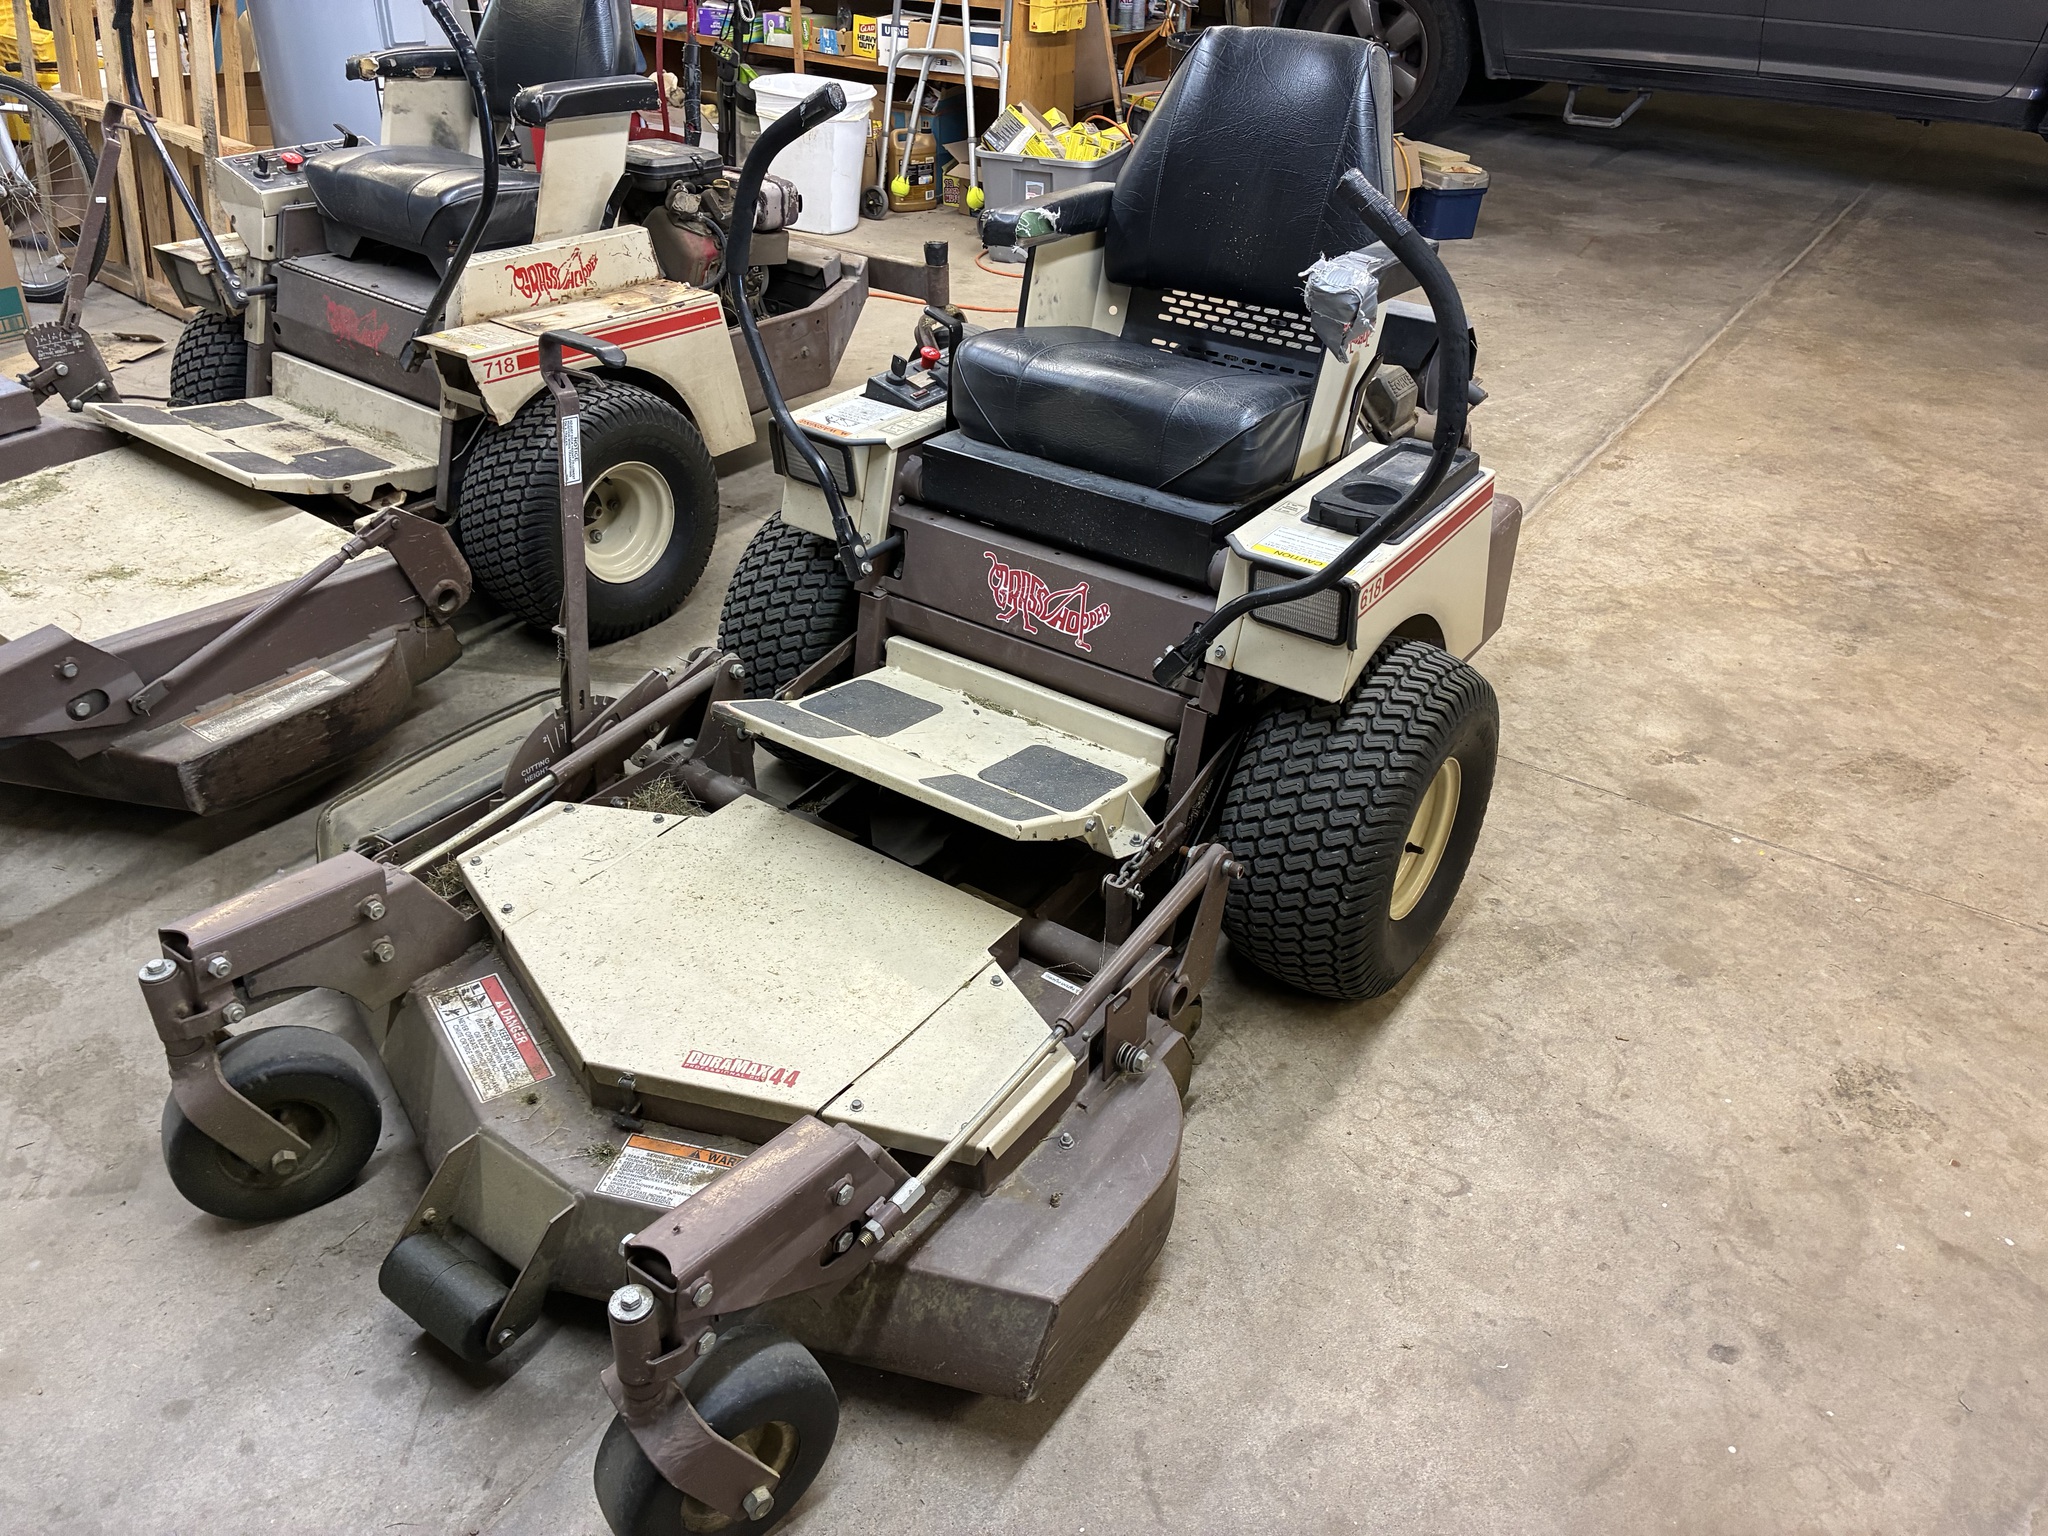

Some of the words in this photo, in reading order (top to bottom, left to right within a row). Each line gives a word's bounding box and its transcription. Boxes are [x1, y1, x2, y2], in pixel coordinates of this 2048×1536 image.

[860, 24, 875, 32] GLAD
[857, 34, 877, 43] HEAVY
[859, 42, 875, 50] DUTY
[483, 357, 515, 378] 718
[1274, 550, 1323, 567] CAUTION
[1360, 577, 1382, 610] 618
[520, 757, 550, 777] CUTTING
[524, 766, 550, 784] HEIGHT
[456, 1017, 469, 1031] NEVER
[464, 1031, 479, 1050] OPERATE
[500, 1008, 528, 1043] DANGER
[481, 1031, 494, 1045] FROM
[497, 1027, 510, 1042] KEEP
[476, 1038, 489, 1052] BLADE
[685, 1050, 773, 1078] DURAMAX
[769, 1068, 800, 1088] 44
